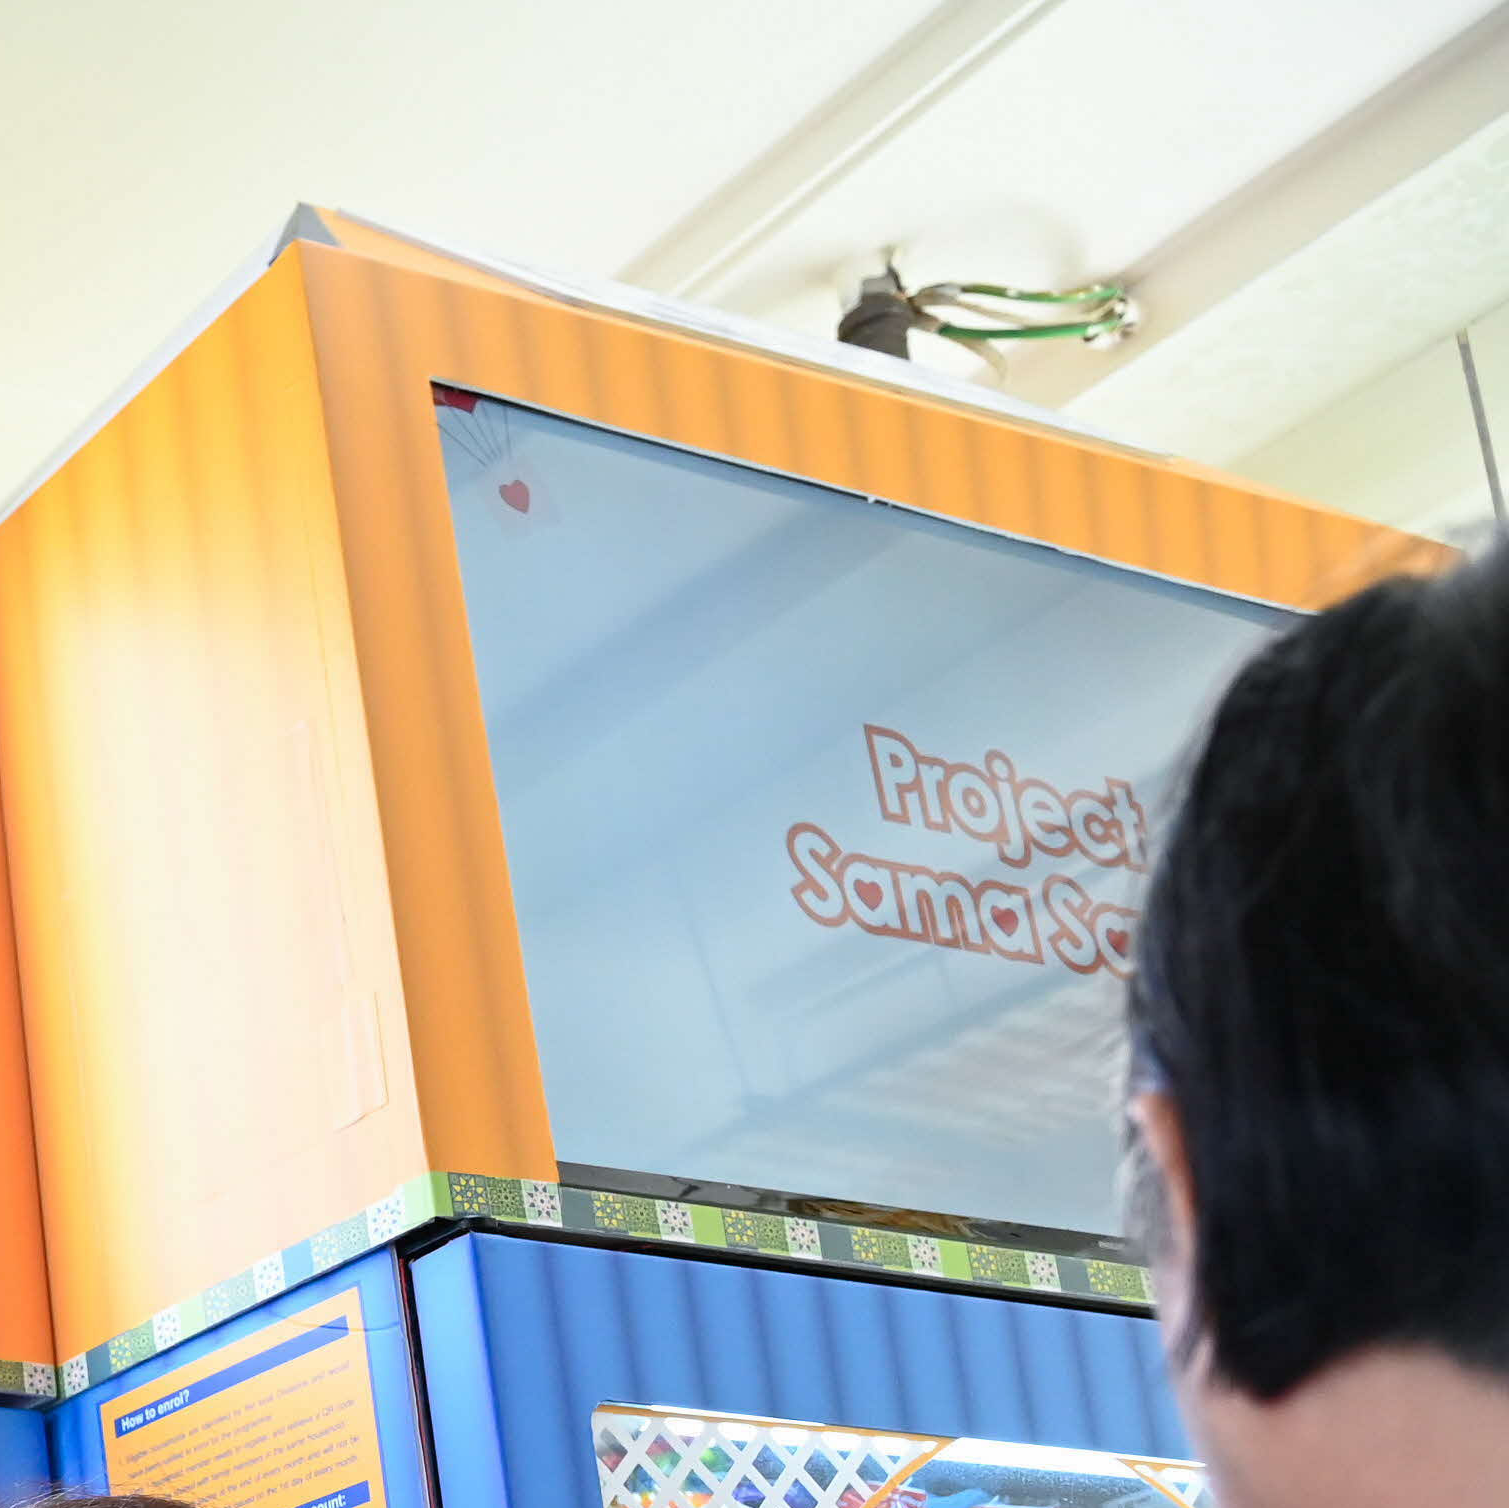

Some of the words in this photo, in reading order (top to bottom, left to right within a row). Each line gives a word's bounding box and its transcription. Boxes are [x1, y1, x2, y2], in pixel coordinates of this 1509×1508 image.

[863, 722, 1149, 874] Project
[785, 822, 1045, 965] Sama
[120, 1413, 144, 1431] How
[157, 1389, 191, 1414] enrol?
